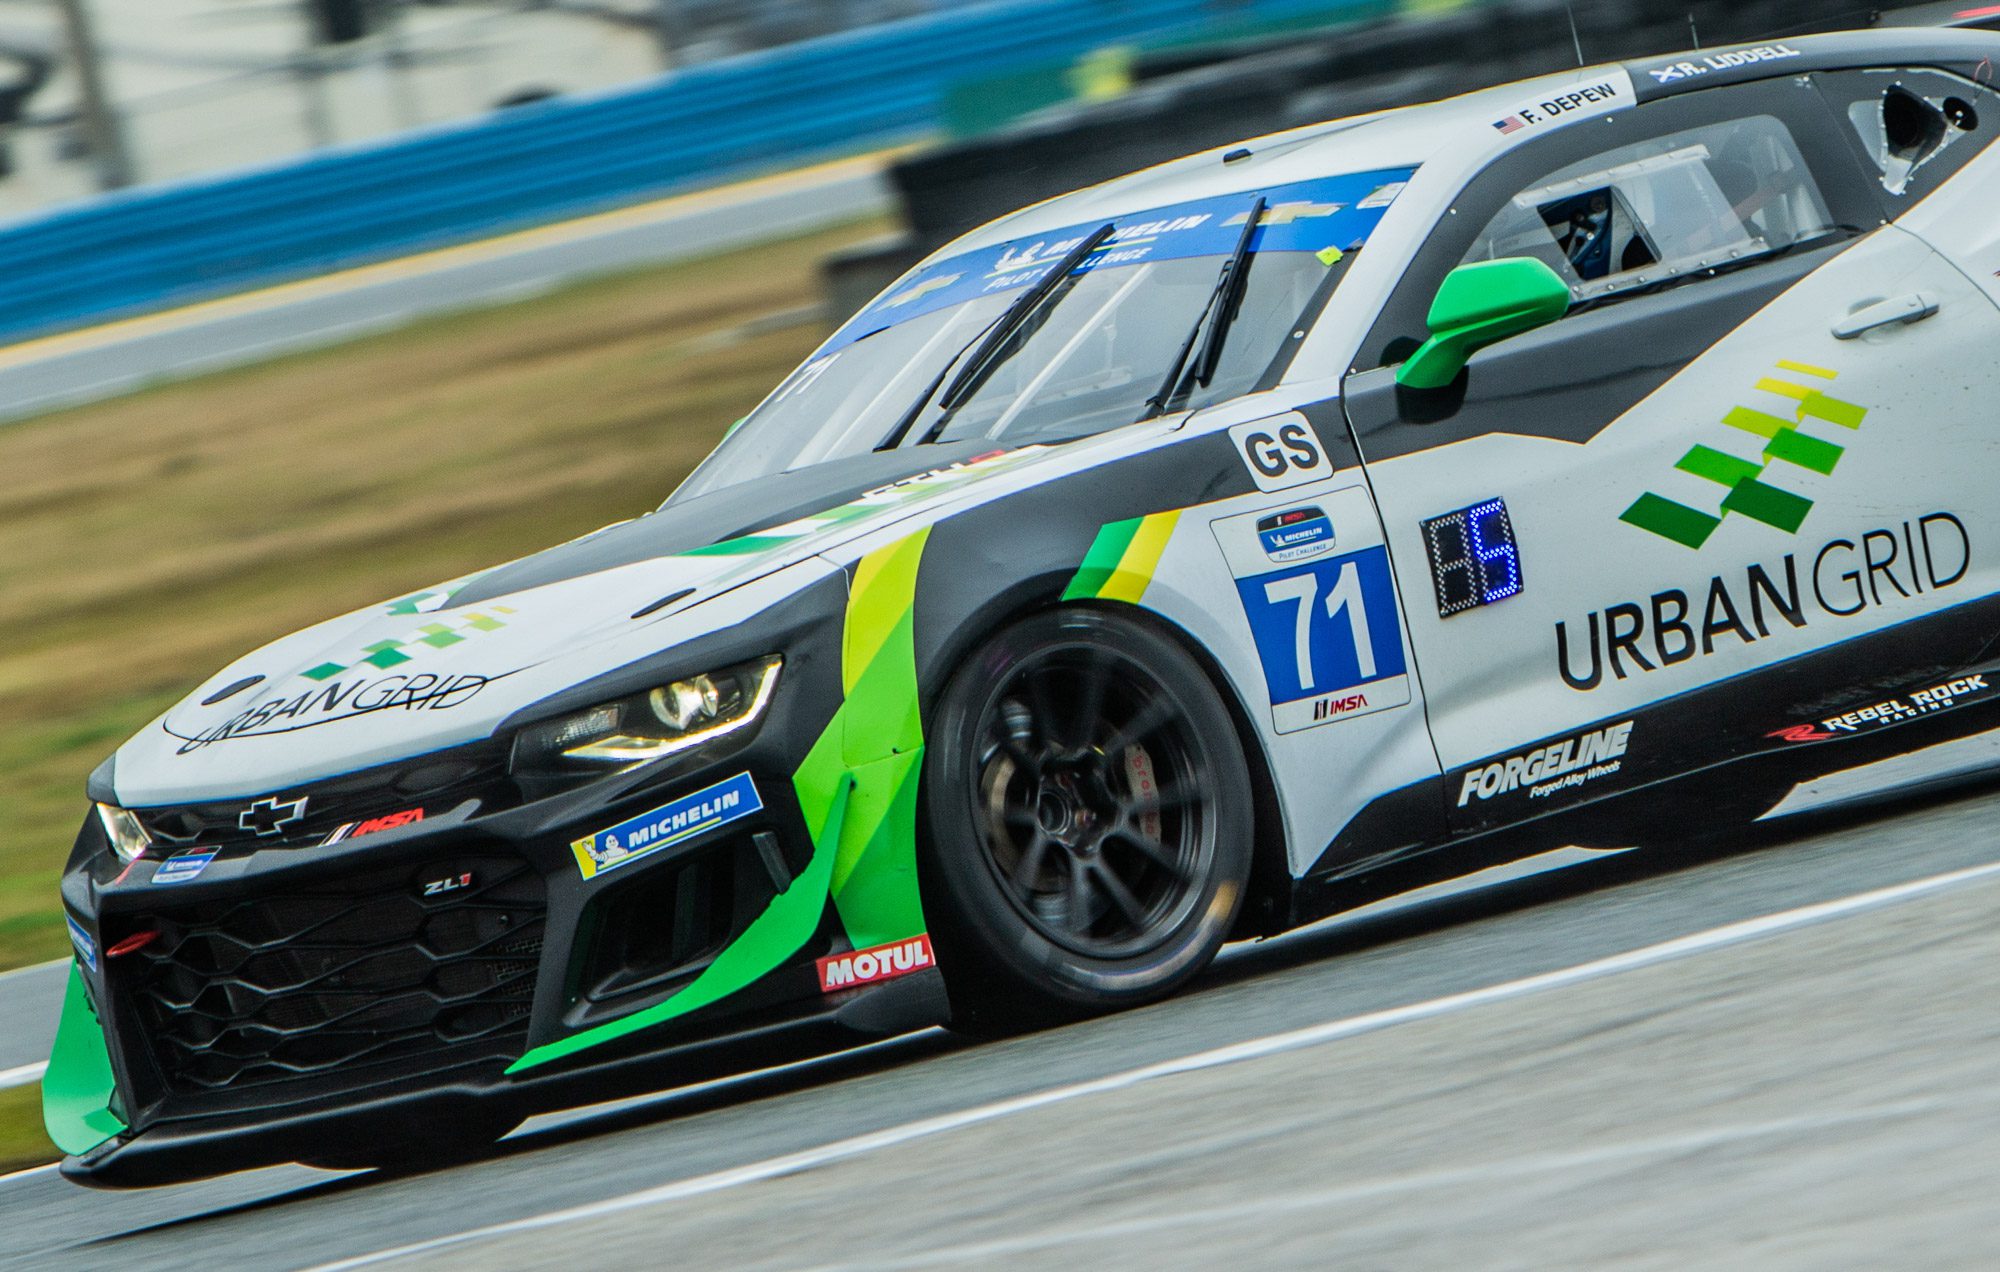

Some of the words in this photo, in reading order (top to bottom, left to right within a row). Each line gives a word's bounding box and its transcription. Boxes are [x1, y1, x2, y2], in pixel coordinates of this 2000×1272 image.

[1680, 60, 1707, 77] R.
[1704, 44, 1800, 69] LIDDELL
[1518, 109, 1542, 125] F.
[1540, 83, 1617, 116] DEPEW
[1244, 424, 1320, 478] GS
[1284, 527, 1323, 542] MICHELIN
[1263, 561, 1377, 690] 71
[1330, 694, 1368, 715] IMSA
[1821, 699, 1910, 731] REBEL
[1909, 674, 1989, 706] ROCK
[1879, 698, 1954, 725] RACING
[1457, 720, 1635, 808] FORGELINE
[1529, 777, 1563, 799] Forged
[1562, 772, 1588, 788] Alloy
[1587, 760, 1621, 780] Wheels
[351, 807, 424, 838] IMSA
[628, 790, 740, 848] MICHELIN
[423, 872, 472, 897] ZL1
[825, 940, 929, 988] MOTUL
